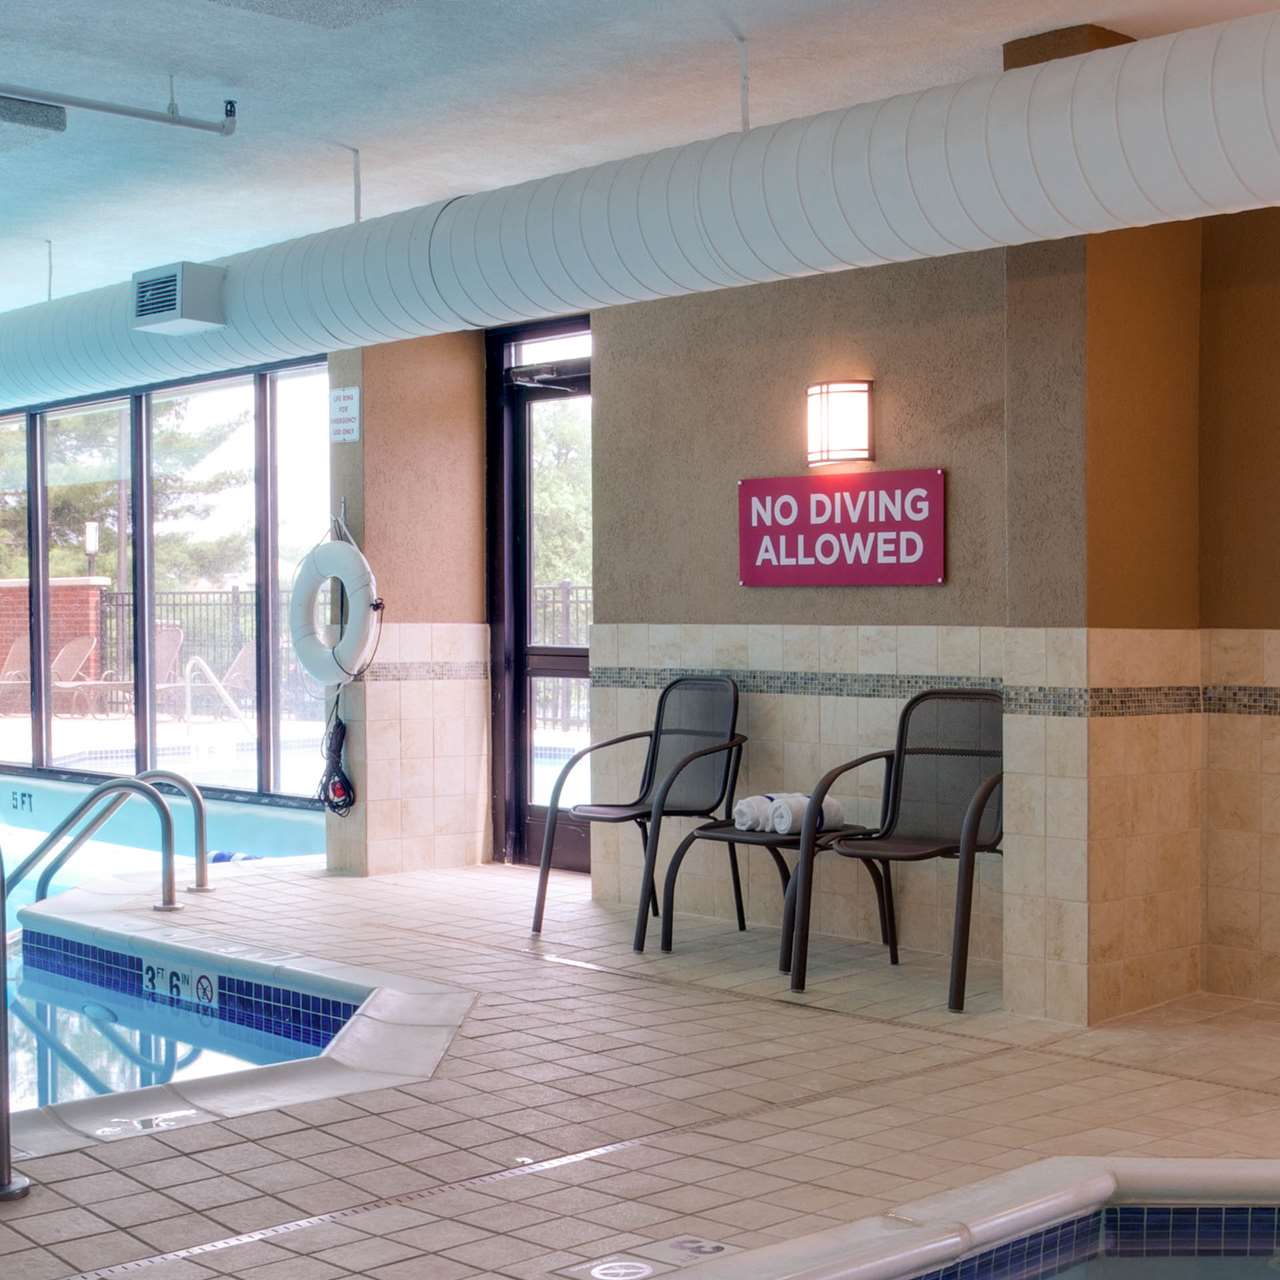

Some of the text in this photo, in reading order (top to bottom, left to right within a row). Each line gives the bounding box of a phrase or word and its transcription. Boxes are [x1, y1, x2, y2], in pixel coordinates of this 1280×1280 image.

[751, 487, 930, 527] NO DIVING
[755, 530, 924, 566] ALLOWED
[11, 791, 18, 809] 5
[144, 966, 156, 990] 3
[168, 971, 181, 997] 6
